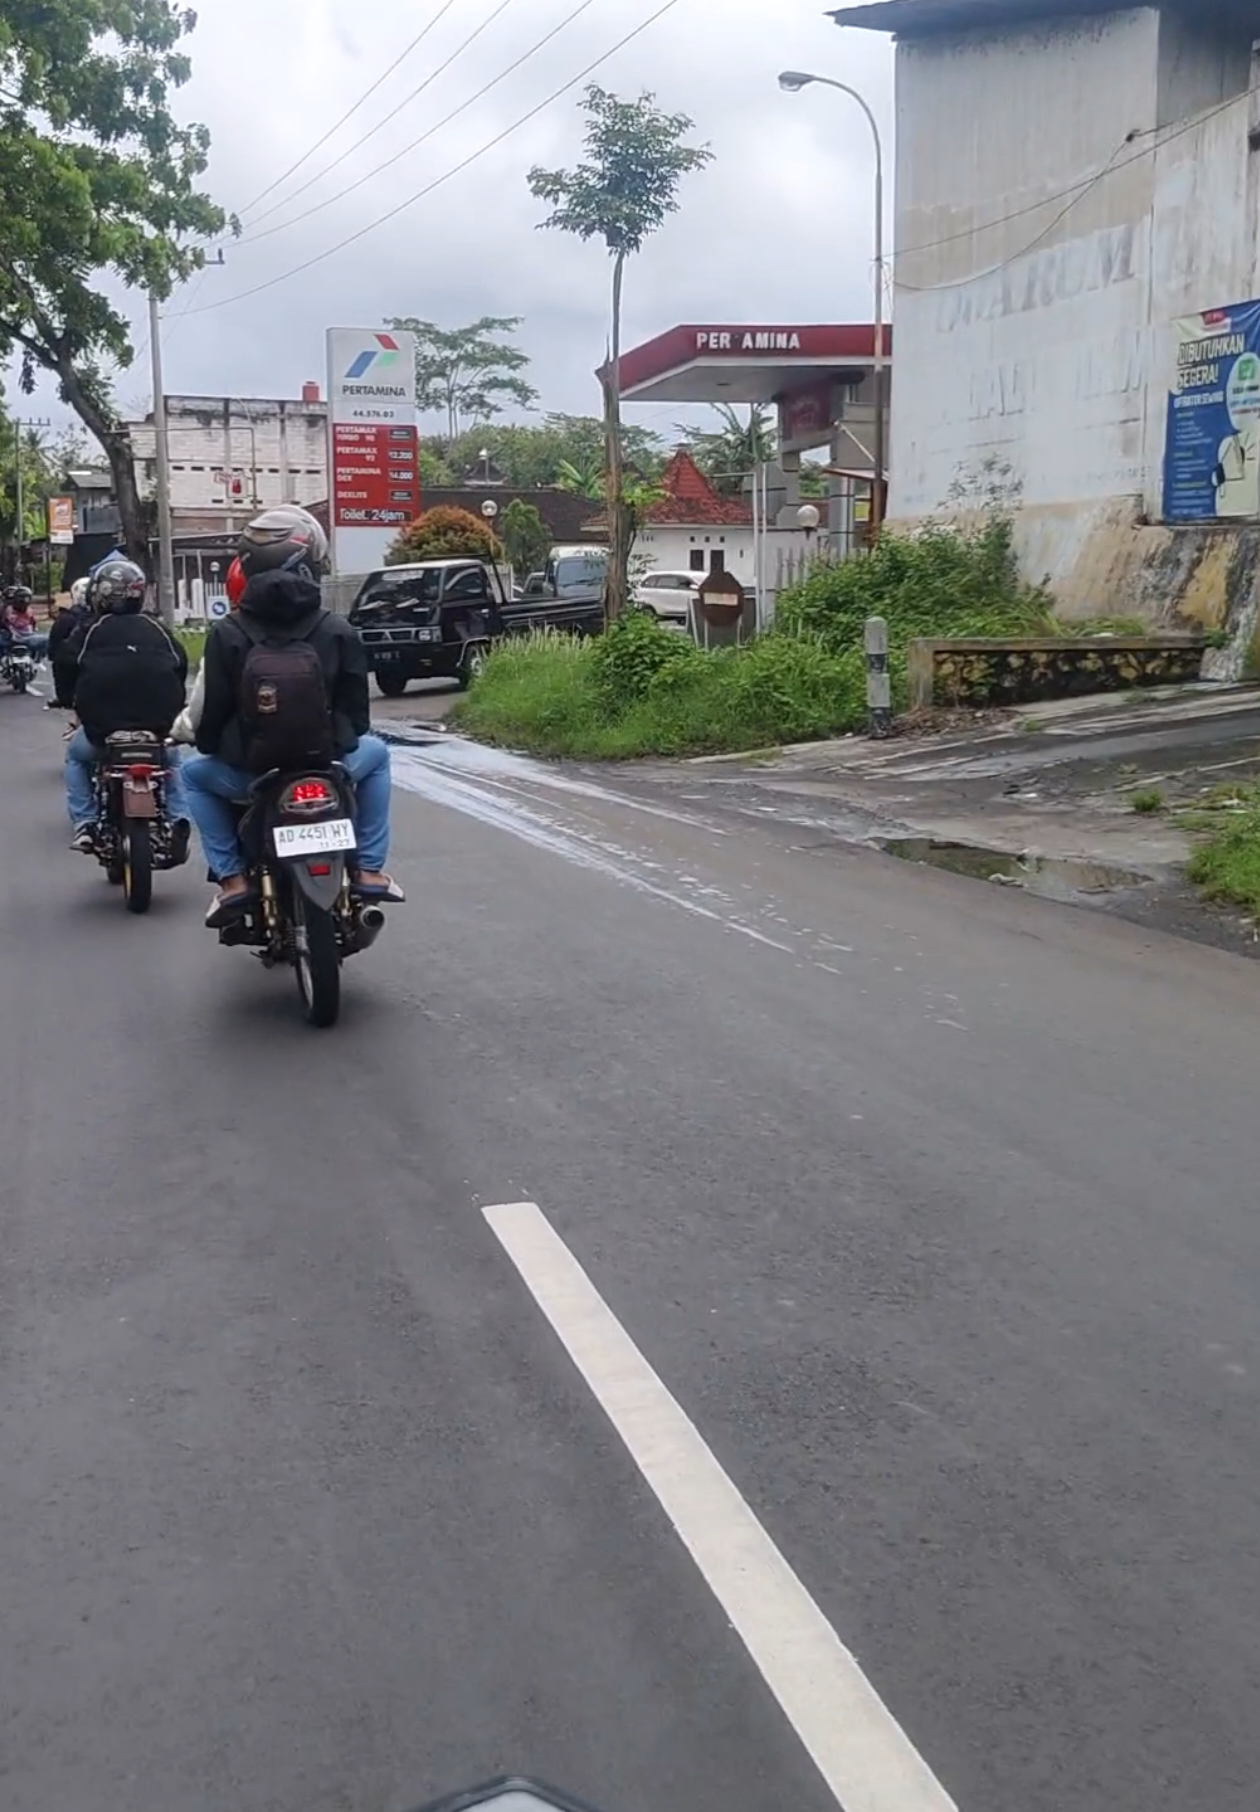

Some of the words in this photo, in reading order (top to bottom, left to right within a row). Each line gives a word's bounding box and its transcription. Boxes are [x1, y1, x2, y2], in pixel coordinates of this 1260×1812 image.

[1178, 332, 1245, 366] DIBUTUHKAN
[342, 385, 406, 397] PERTAMINA
[336, 426, 377, 434] PERTAMAX
[337, 446, 378, 454] PERTAMAX
[337, 467, 381, 475] PERTAMINA
[337, 474, 352, 482] DEX
[371, 509, 405, 522] 24jam
[278, 830, 295, 843] AD
[299, 826, 327, 840] 4451
